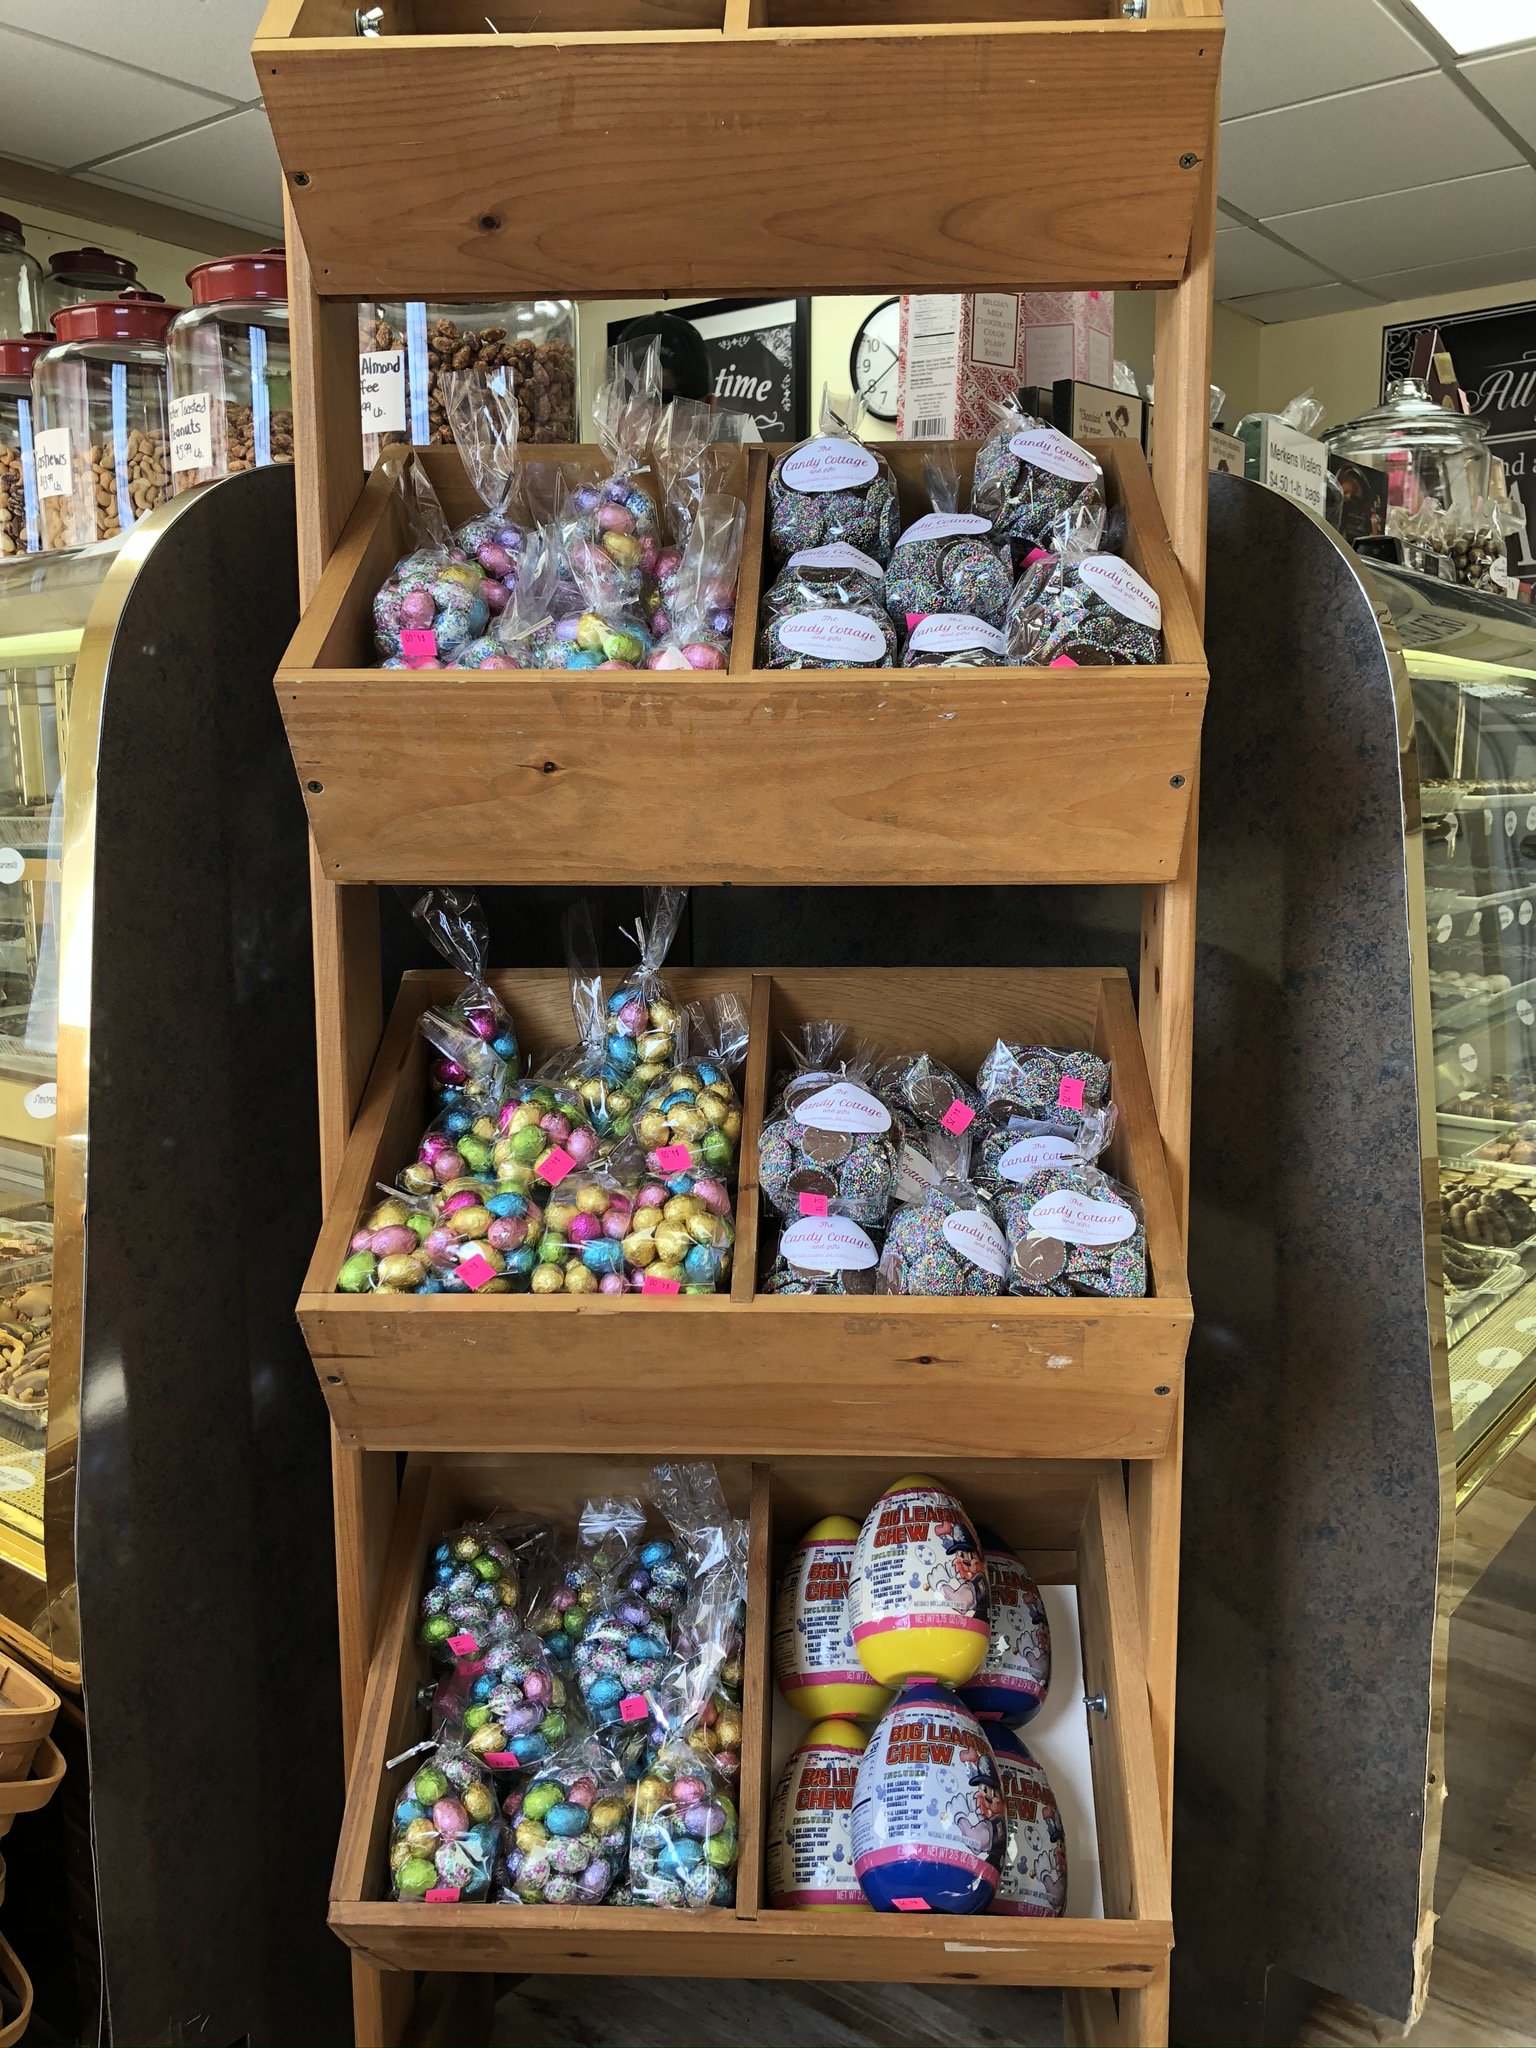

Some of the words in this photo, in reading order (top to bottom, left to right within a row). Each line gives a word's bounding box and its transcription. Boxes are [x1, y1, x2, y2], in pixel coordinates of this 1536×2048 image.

[975, 317, 1014, 330] CHOCOLATE
[865, 339, 880, 353] 10
[361, 356, 400, 375] Almond
[863, 359, 871, 373] 9
[360, 379, 380, 395] fee
[714, 363, 773, 401] time
[868, 379, 877, 394] 8
[880, 391, 888, 404] 7
[785, 457, 820, 472] Candy
[824, 455, 868, 467] Cottage
[1013, 439, 1051, 451] Candy
[1054, 445, 1090, 470] Cottage
[1270, 442, 1299, 468] Merkens
[1300, 452, 1322, 476] Wafers
[1269, 470, 1288, 492] $4.50
[1304, 483, 1320, 506] bags
[1083, 563, 1122, 586] Candy
[1125, 581, 1160, 613] Cottage
[783, 624, 824, 635] Candy
[829, 625, 876, 642] Cottage
[956, 624, 1002, 641] Cottage
[800, 1098, 835, 1112] Candy
[839, 1099, 882, 1118] Cottage
[1002, 1153, 1038, 1168] Candy
[1033, 1205, 1072, 1219] Candy
[1077, 1211, 1124, 1225] Cottage
[947, 1219, 984, 1242] Candy
[784, 1232, 823, 1245] Candy
[827, 1232, 871, 1250] Cottage
[877, 1510, 901, 1530] BIG
[873, 1523, 930, 1549] CHEW
[807, 1562, 838, 1581] BIG
[889, 1722, 924, 1745] BIG
[886, 1742, 954, 1767] CHEW
[799, 1768, 831, 1788] BIG
[795, 1788, 854, 1811] CHEW
